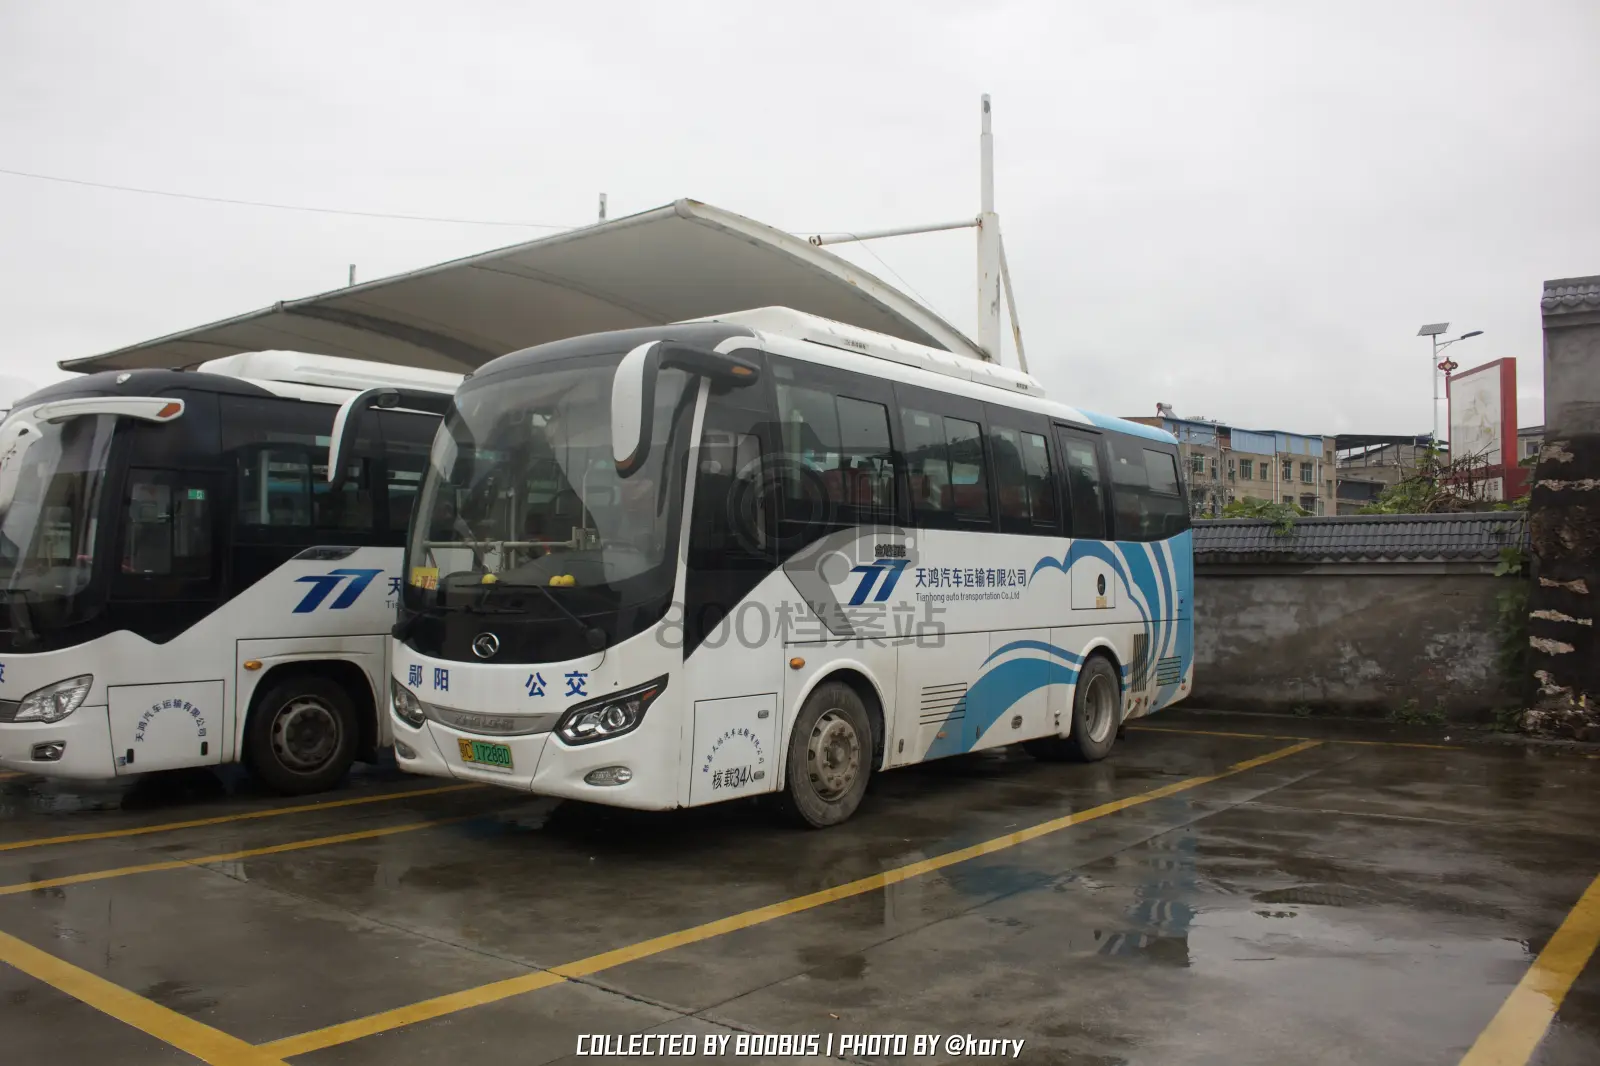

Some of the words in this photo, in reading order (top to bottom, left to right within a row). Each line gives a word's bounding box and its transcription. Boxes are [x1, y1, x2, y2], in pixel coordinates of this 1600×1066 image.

[915, 567, 1027, 588] 天鸿汽车运输有限公司
[916, 593, 945, 603] Tianhong
[946, 592, 959, 601] auto
[961, 590, 1000, 602] transportation
[408, 664, 449, 691] 郧阳
[525, 670, 588, 697] 公交
[135, 699, 207, 742] 天鸿汽车运输有限公司
[712, 764, 754, 790] 核载34人
